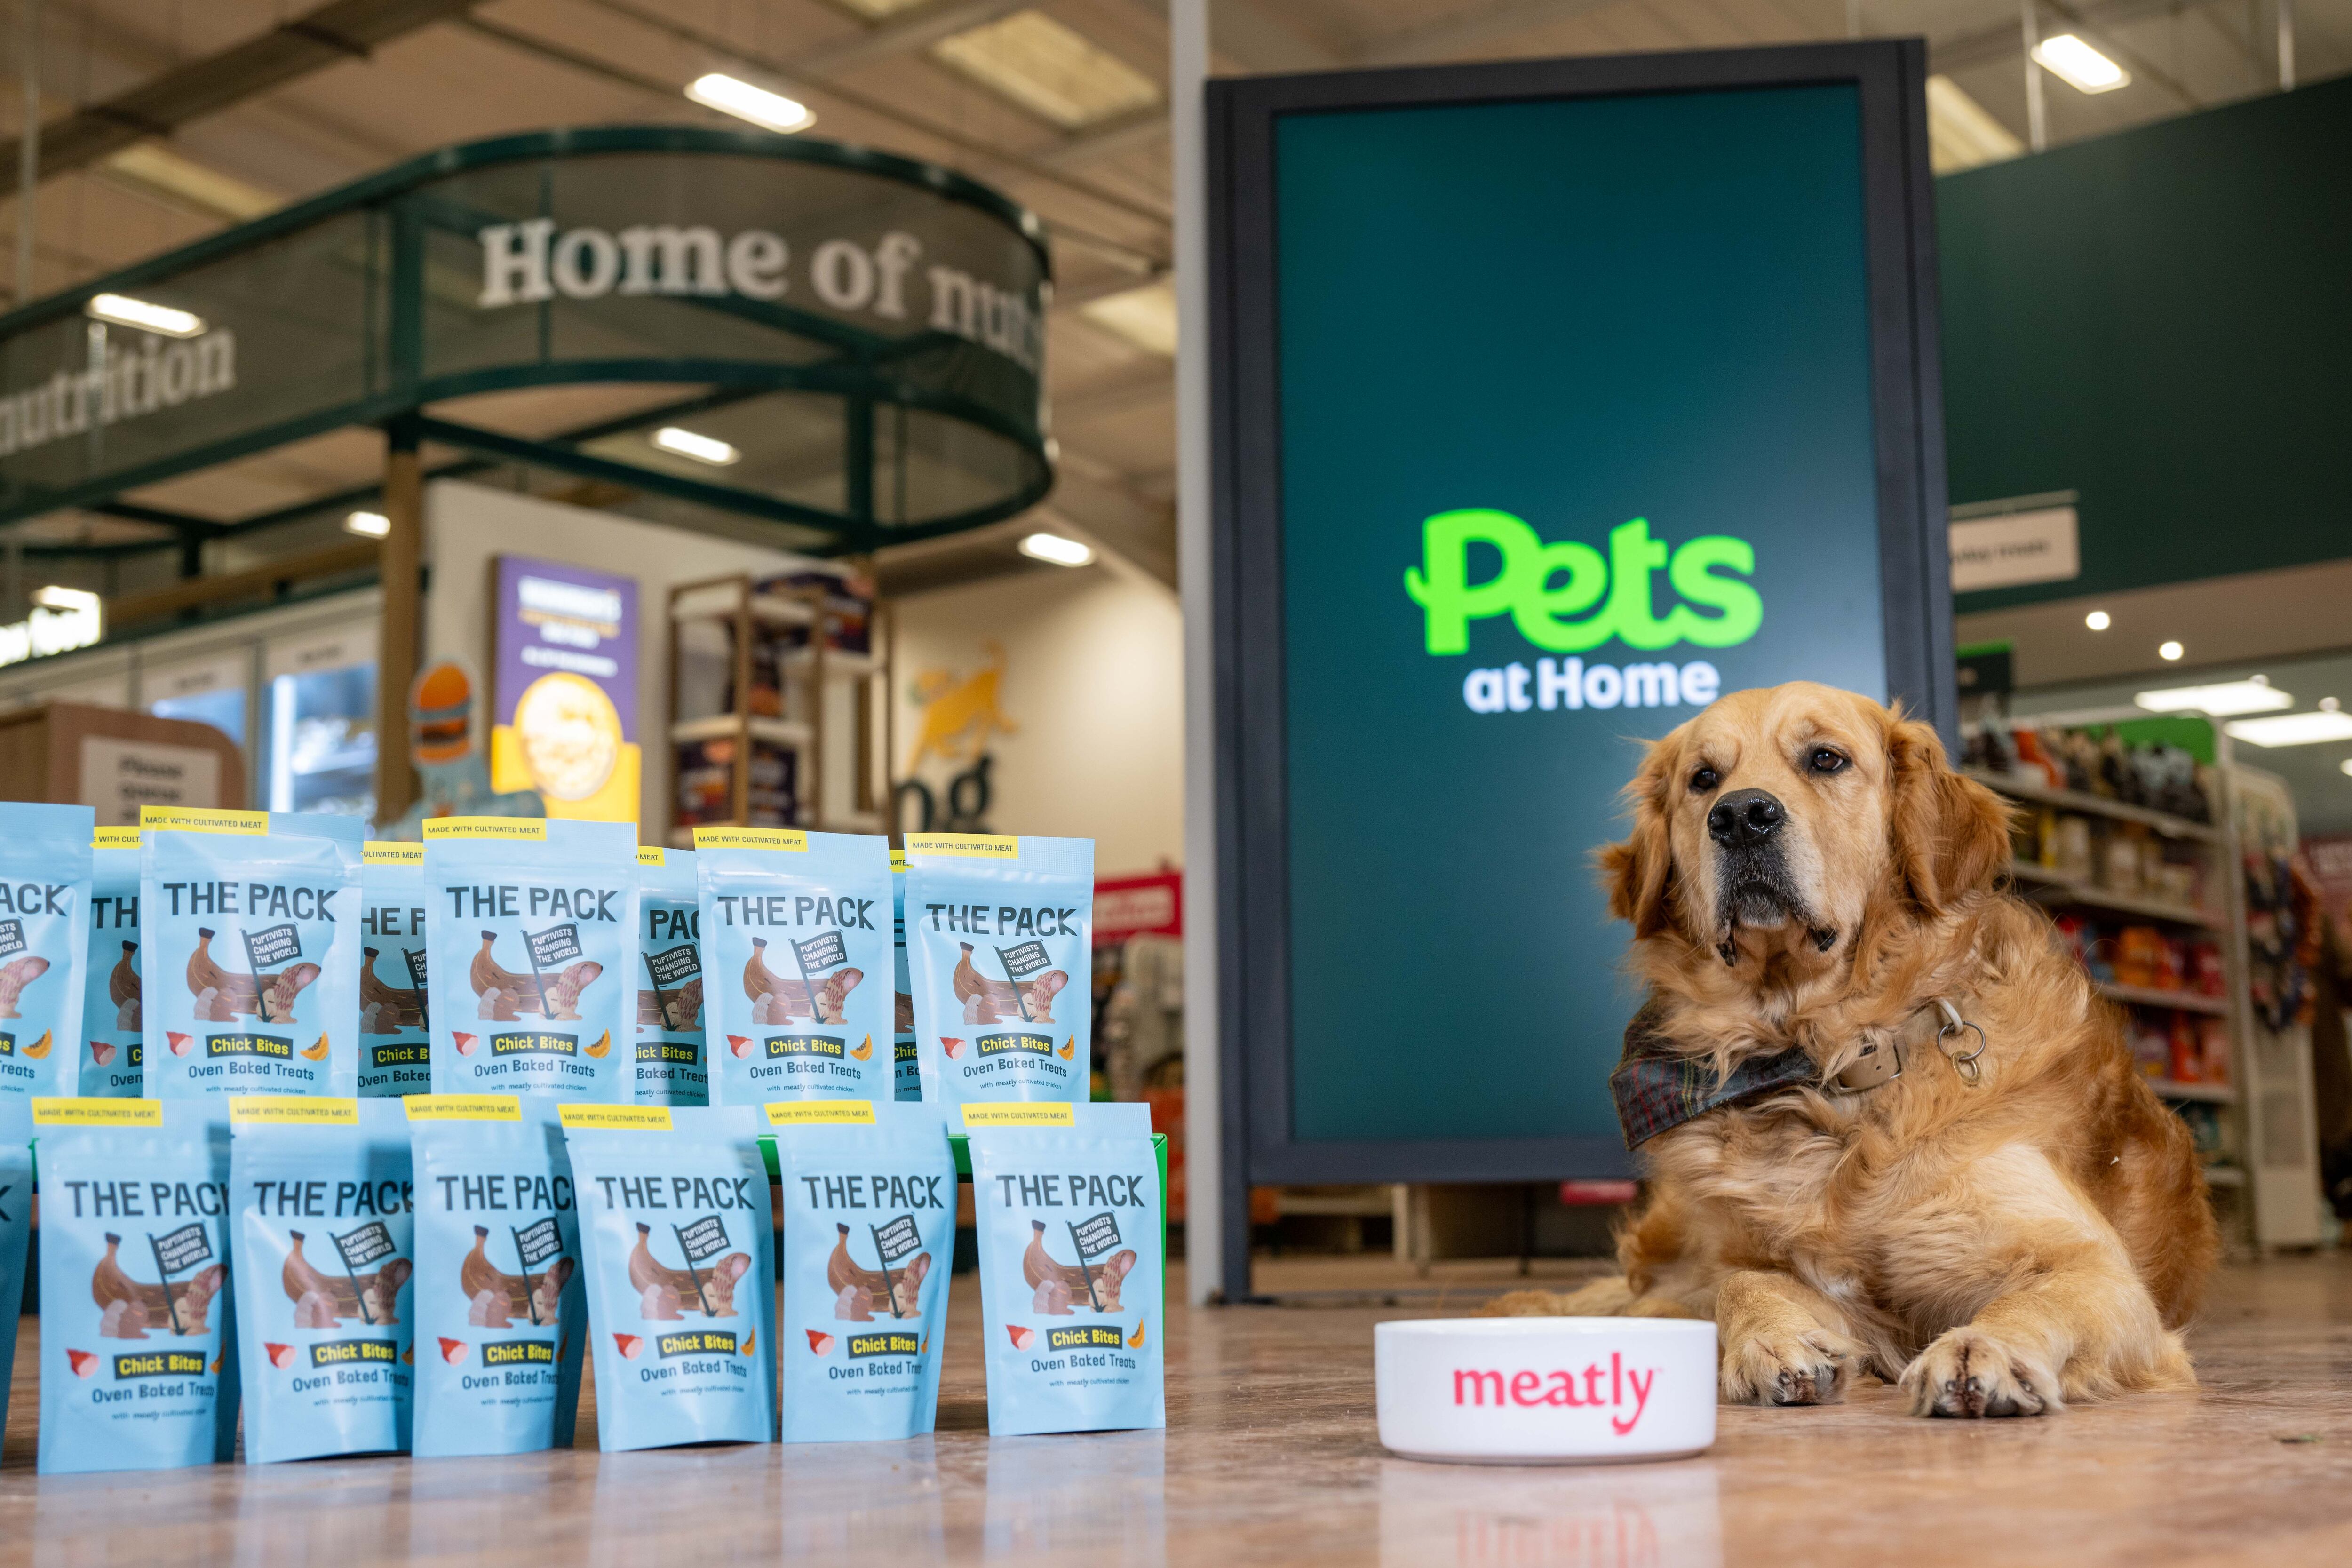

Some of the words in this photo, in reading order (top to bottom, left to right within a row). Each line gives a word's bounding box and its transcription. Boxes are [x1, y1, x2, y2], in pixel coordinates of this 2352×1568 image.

[477, 216, 791, 309] Home
[810, 231, 924, 319] of
[1404, 507, 1764, 656] Pets
[1463, 661, 1533, 714] at
[1536, 656, 1721, 712] Home
[193, 819, 237, 827] CULTIVATED
[0, 883, 69, 916] ACK
[163, 881, 239, 915] THE
[249, 883, 338, 922] PACK
[446, 885, 520, 918] THE
[530, 887, 618, 922] PACK
[718, 896, 787, 926] THE
[795, 896, 875, 930] PACK
[926, 904, 990, 935] THE
[999, 907, 1078, 937] PACK
[650, 909, 699, 939] PAC
[251, 928, 292, 945] PUPTIVISTS
[532, 928, 572, 945] PUPTIVISTS
[800, 935, 837, 953] PUPTIVISTS
[253, 938, 292, 954] CHANGING
[254, 954, 272, 963] THE
[273, 946, 298, 960] WORLD
[534, 938, 571, 955] CHANGING
[536, 955, 553, 963] THE
[554, 947, 578, 960] WORLD
[803, 944, 837, 961] CHANGING
[1003, 944, 1039, 959] PUPTIVISTS
[652, 948, 691, 965] PUPTIVISTS
[655, 957, 690, 973] CHANGING
[805, 961, 820, 969] THE
[821, 953, 844, 965] WORLD
[1007, 952, 1040, 967] CHANGING
[1025, 958, 1047, 971] WORLD
[657, 972, 673, 981] THE
[674, 964, 697, 978] WORLD
[212, 1038, 252, 1053] Chick
[256, 1038, 289, 1055] Bites
[496, 1036, 534, 1051] Chick
[540, 1036, 573, 1051] Bites
[770, 1039, 806, 1054] Chick
[811, 1039, 841, 1054] Bites
[981, 1037, 1016, 1052] Chick
[1021, 1036, 1049, 1051] Bites
[378, 1048, 414, 1062] Chick
[662, 1046, 693, 1060] Bites
[189, 1065, 223, 1078] Oven
[229, 1062, 270, 1075] Baked
[275, 1063, 314, 1080] Treats
[474, 1063, 507, 1077] Oven
[512, 1059, 554, 1072] Baked
[559, 1060, 595, 1077] Treats
[637, 1068, 675, 1079] Baked
[679, 1068, 707, 1084] Treat
[750, 1066, 782, 1078] Oven
[787, 1061, 824, 1073] Baked
[829, 1063, 861, 1079] Treats
[963, 1063, 993, 1077] Oven
[998, 1058, 1034, 1070] Baked
[1039, 1059, 1067, 1077] Treats
[111, 1075, 142, 1087] Oven
[358, 1075, 388, 1087] Oven
[64, 1181, 143, 1217] THE
[253, 1182, 326, 1216] THE
[437, 1175, 507, 1210] THE
[515, 1176, 577, 1210] PAC
[596, 1176, 667, 1209] THE
[672, 1177, 755, 1210] PACK
[801, 1175, 866, 1209] THE
[872, 1175, 944, 1209] PACK
[996, 1174, 1062, 1207] THE
[1068, 1174, 1145, 1207] PACK
[1081, 1244, 1097, 1254] THE
[1096, 1234, 1118, 1250] WORLD
[662, 1335, 700, 1353] Chick
[704, 1335, 734, 1351] Bites
[852, 1337, 887, 1354] Chick
[890, 1337, 916, 1352] Bites
[1052, 1329, 1089, 1346] Chick
[1092, 1329, 1120, 1345] Bites
[316, 1344, 358, 1363] Chick
[361, 1343, 394, 1360] Bites
[487, 1345, 524, 1362] Chick
[528, 1344, 552, 1361] Bites
[119, 1356, 164, 1375] Chick
[169, 1355, 202, 1371] Bites
[640, 1367, 677, 1382] Oven
[682, 1361, 720, 1375] Baked
[829, 1366, 864, 1379] Oven
[869, 1361, 902, 1376] Baked
[1031, 1360, 1065, 1372] Oven
[1070, 1354, 1106, 1368] Baked
[1109, 1353, 1136, 1369] Treats
[293, 1377, 330, 1392] Oven
[337, 1369, 378, 1385] Baked
[462, 1376, 500, 1389] Oven
[505, 1370, 538, 1385] Baked
[94, 1389, 132, 1402] Oven
[139, 1383, 184, 1398] Baked
[1453, 1351, 1654, 1437] meatly
